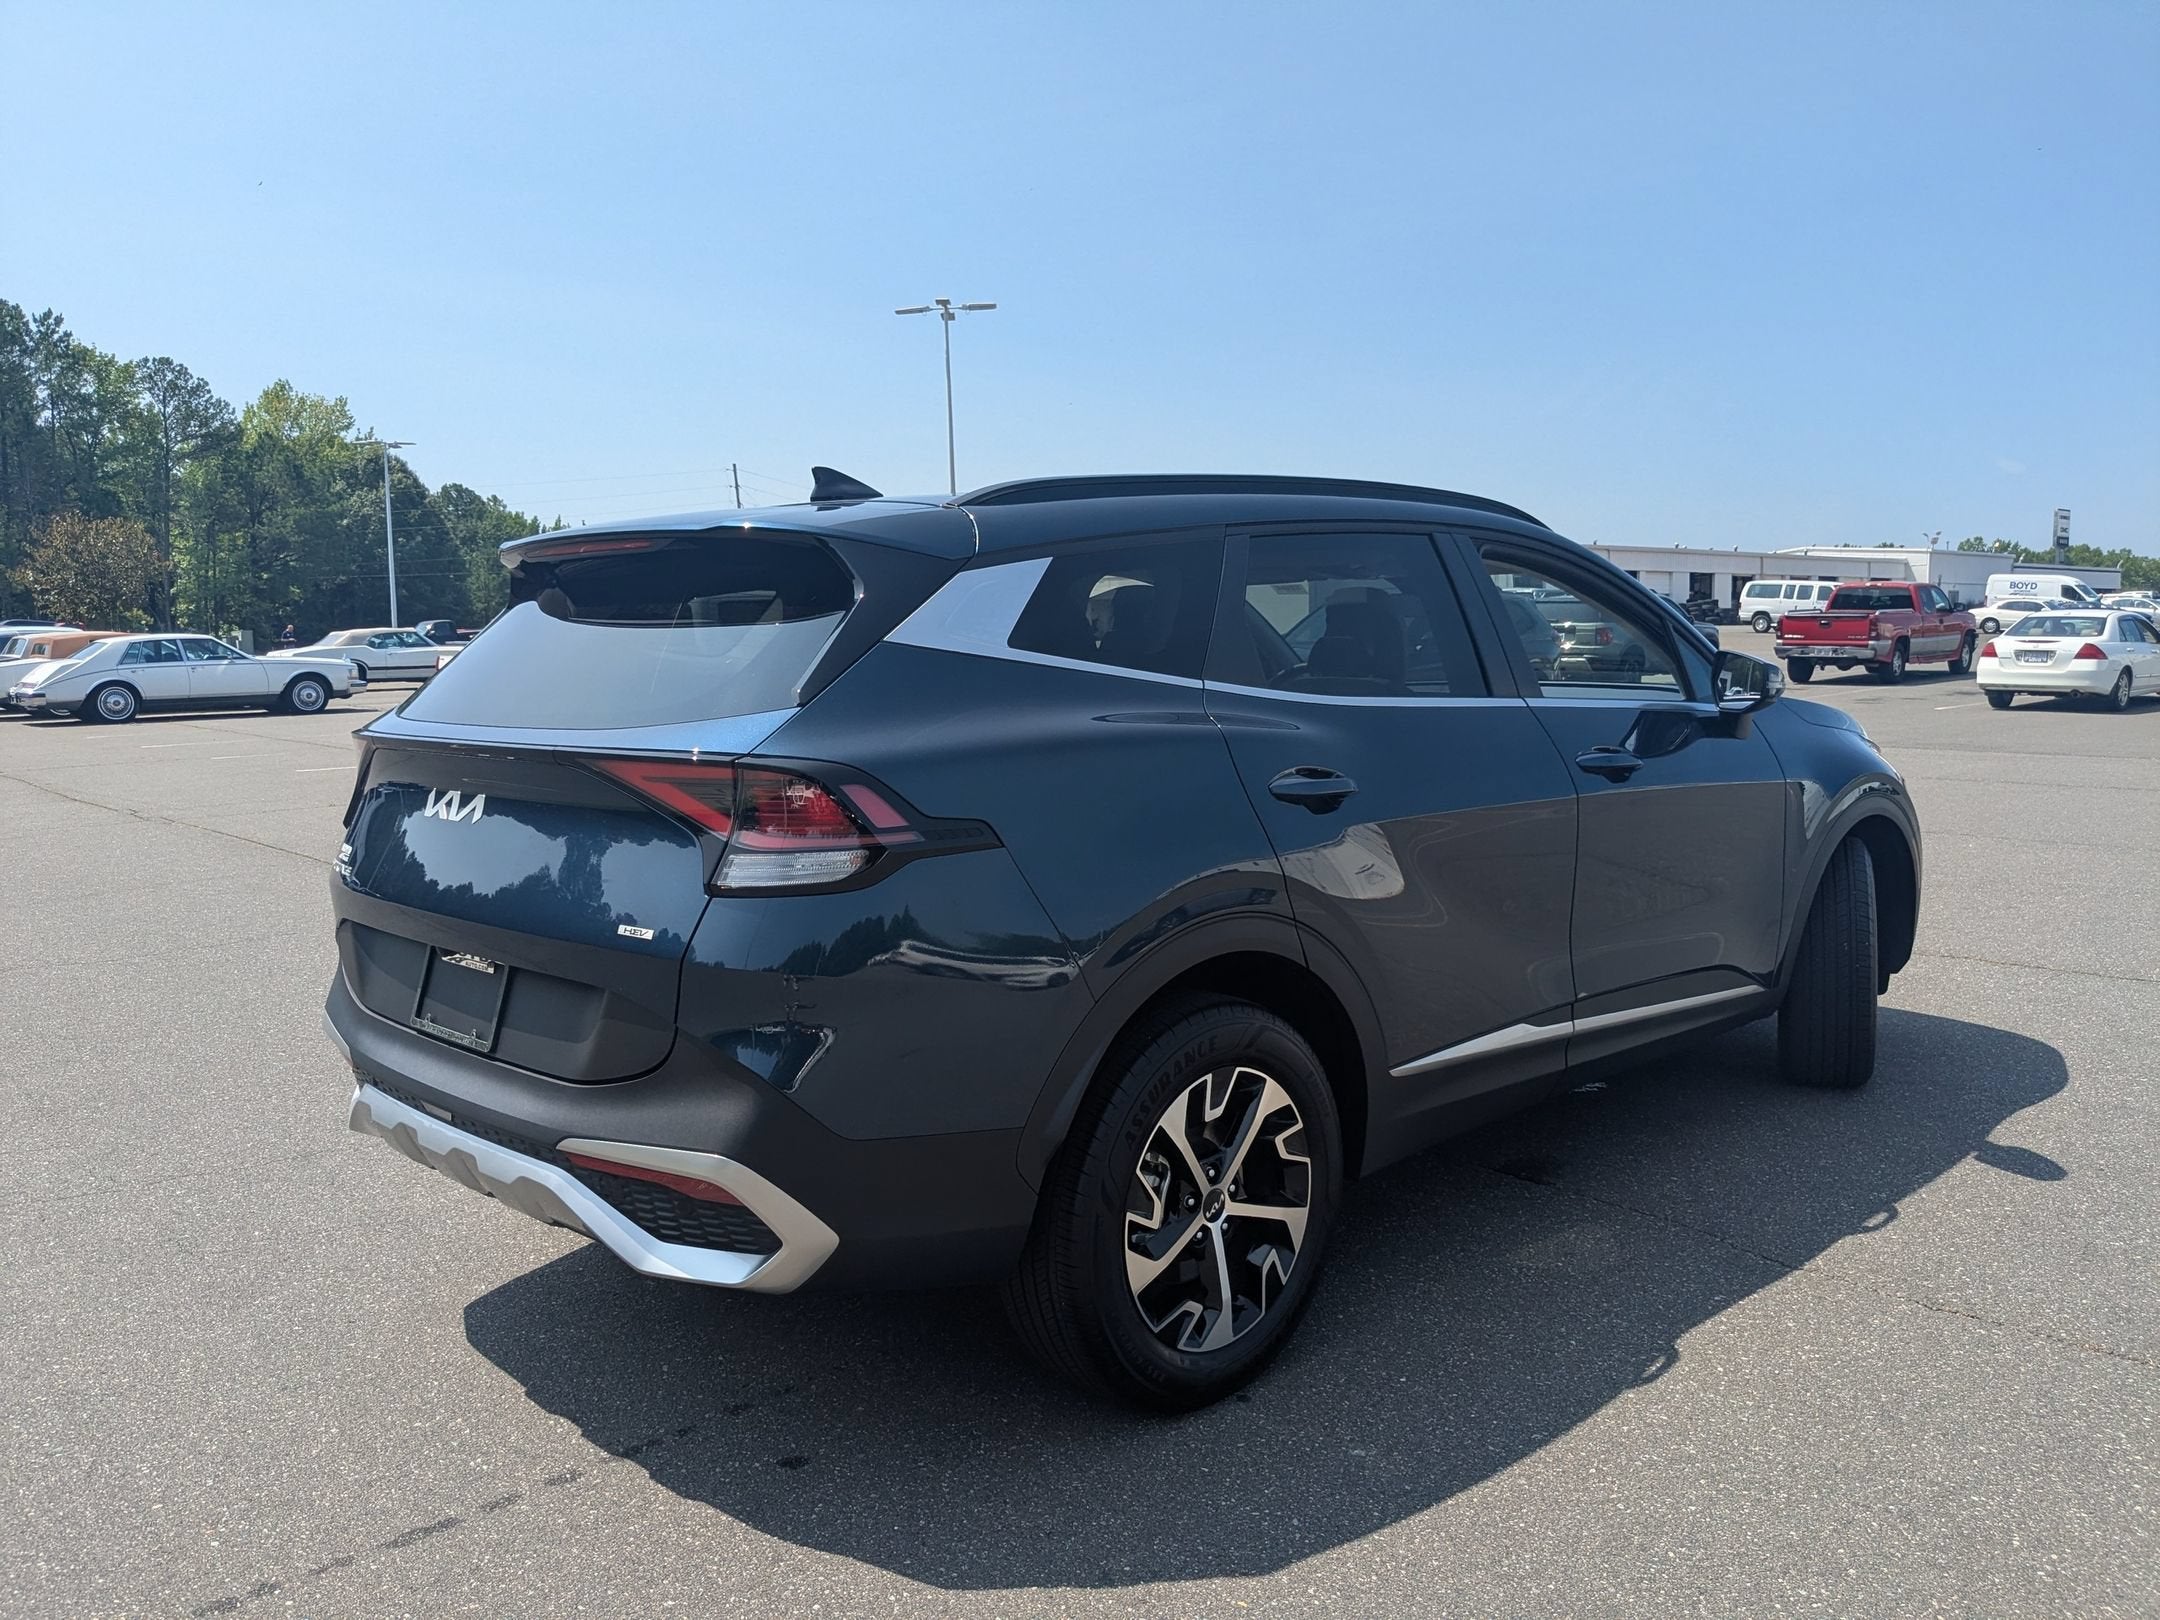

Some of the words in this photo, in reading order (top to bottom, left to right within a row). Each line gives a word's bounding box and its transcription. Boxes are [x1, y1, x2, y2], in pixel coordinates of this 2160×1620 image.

[2009, 581, 2038, 590] BOYD
[424, 787, 486, 825] KIA
[623, 926, 649, 937] HEV
[1123, 1035, 1219, 1152] ASSURANCE
